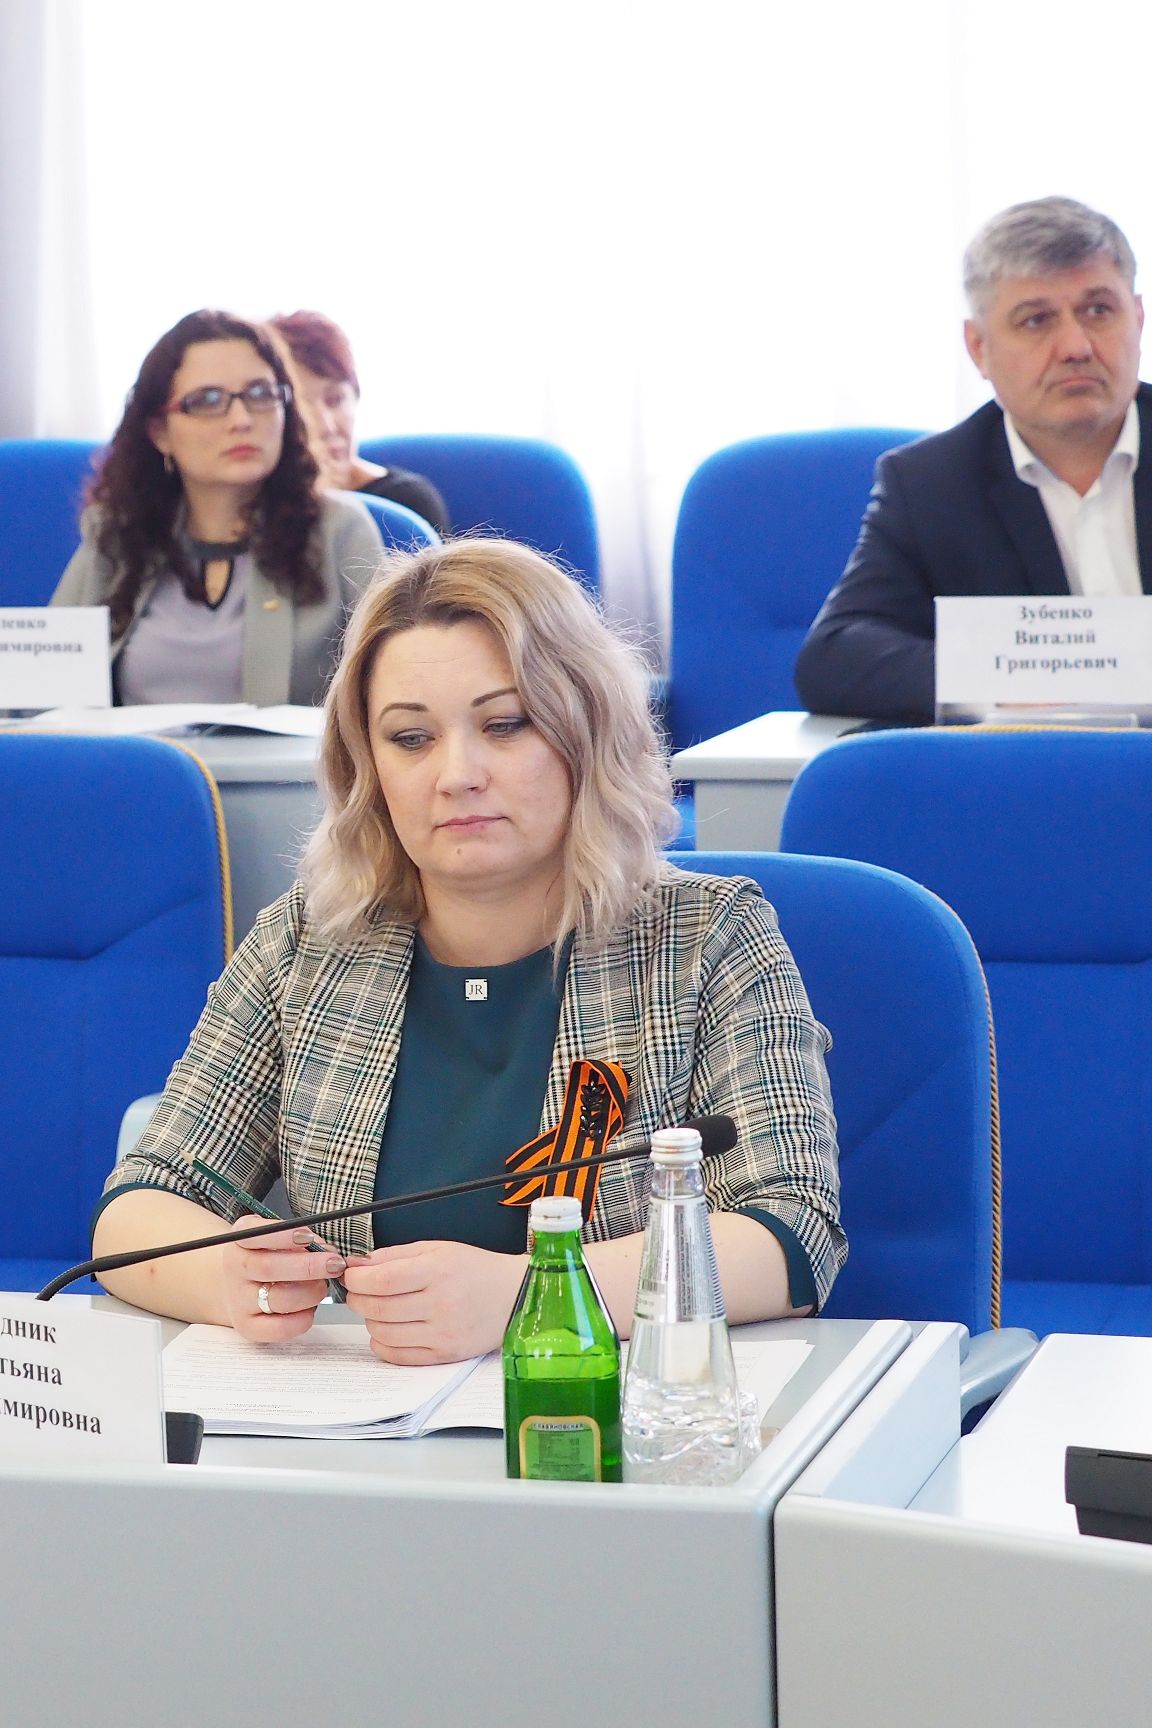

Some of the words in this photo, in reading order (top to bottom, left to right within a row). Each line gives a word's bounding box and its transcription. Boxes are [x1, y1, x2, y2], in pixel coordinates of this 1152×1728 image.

[1020, 605, 1093, 624] Зубенко
[1015, 629, 1096, 645] Виталий
[995, 655, 1118, 674] Григорьевич
[468, 984, 483, 995] JR
